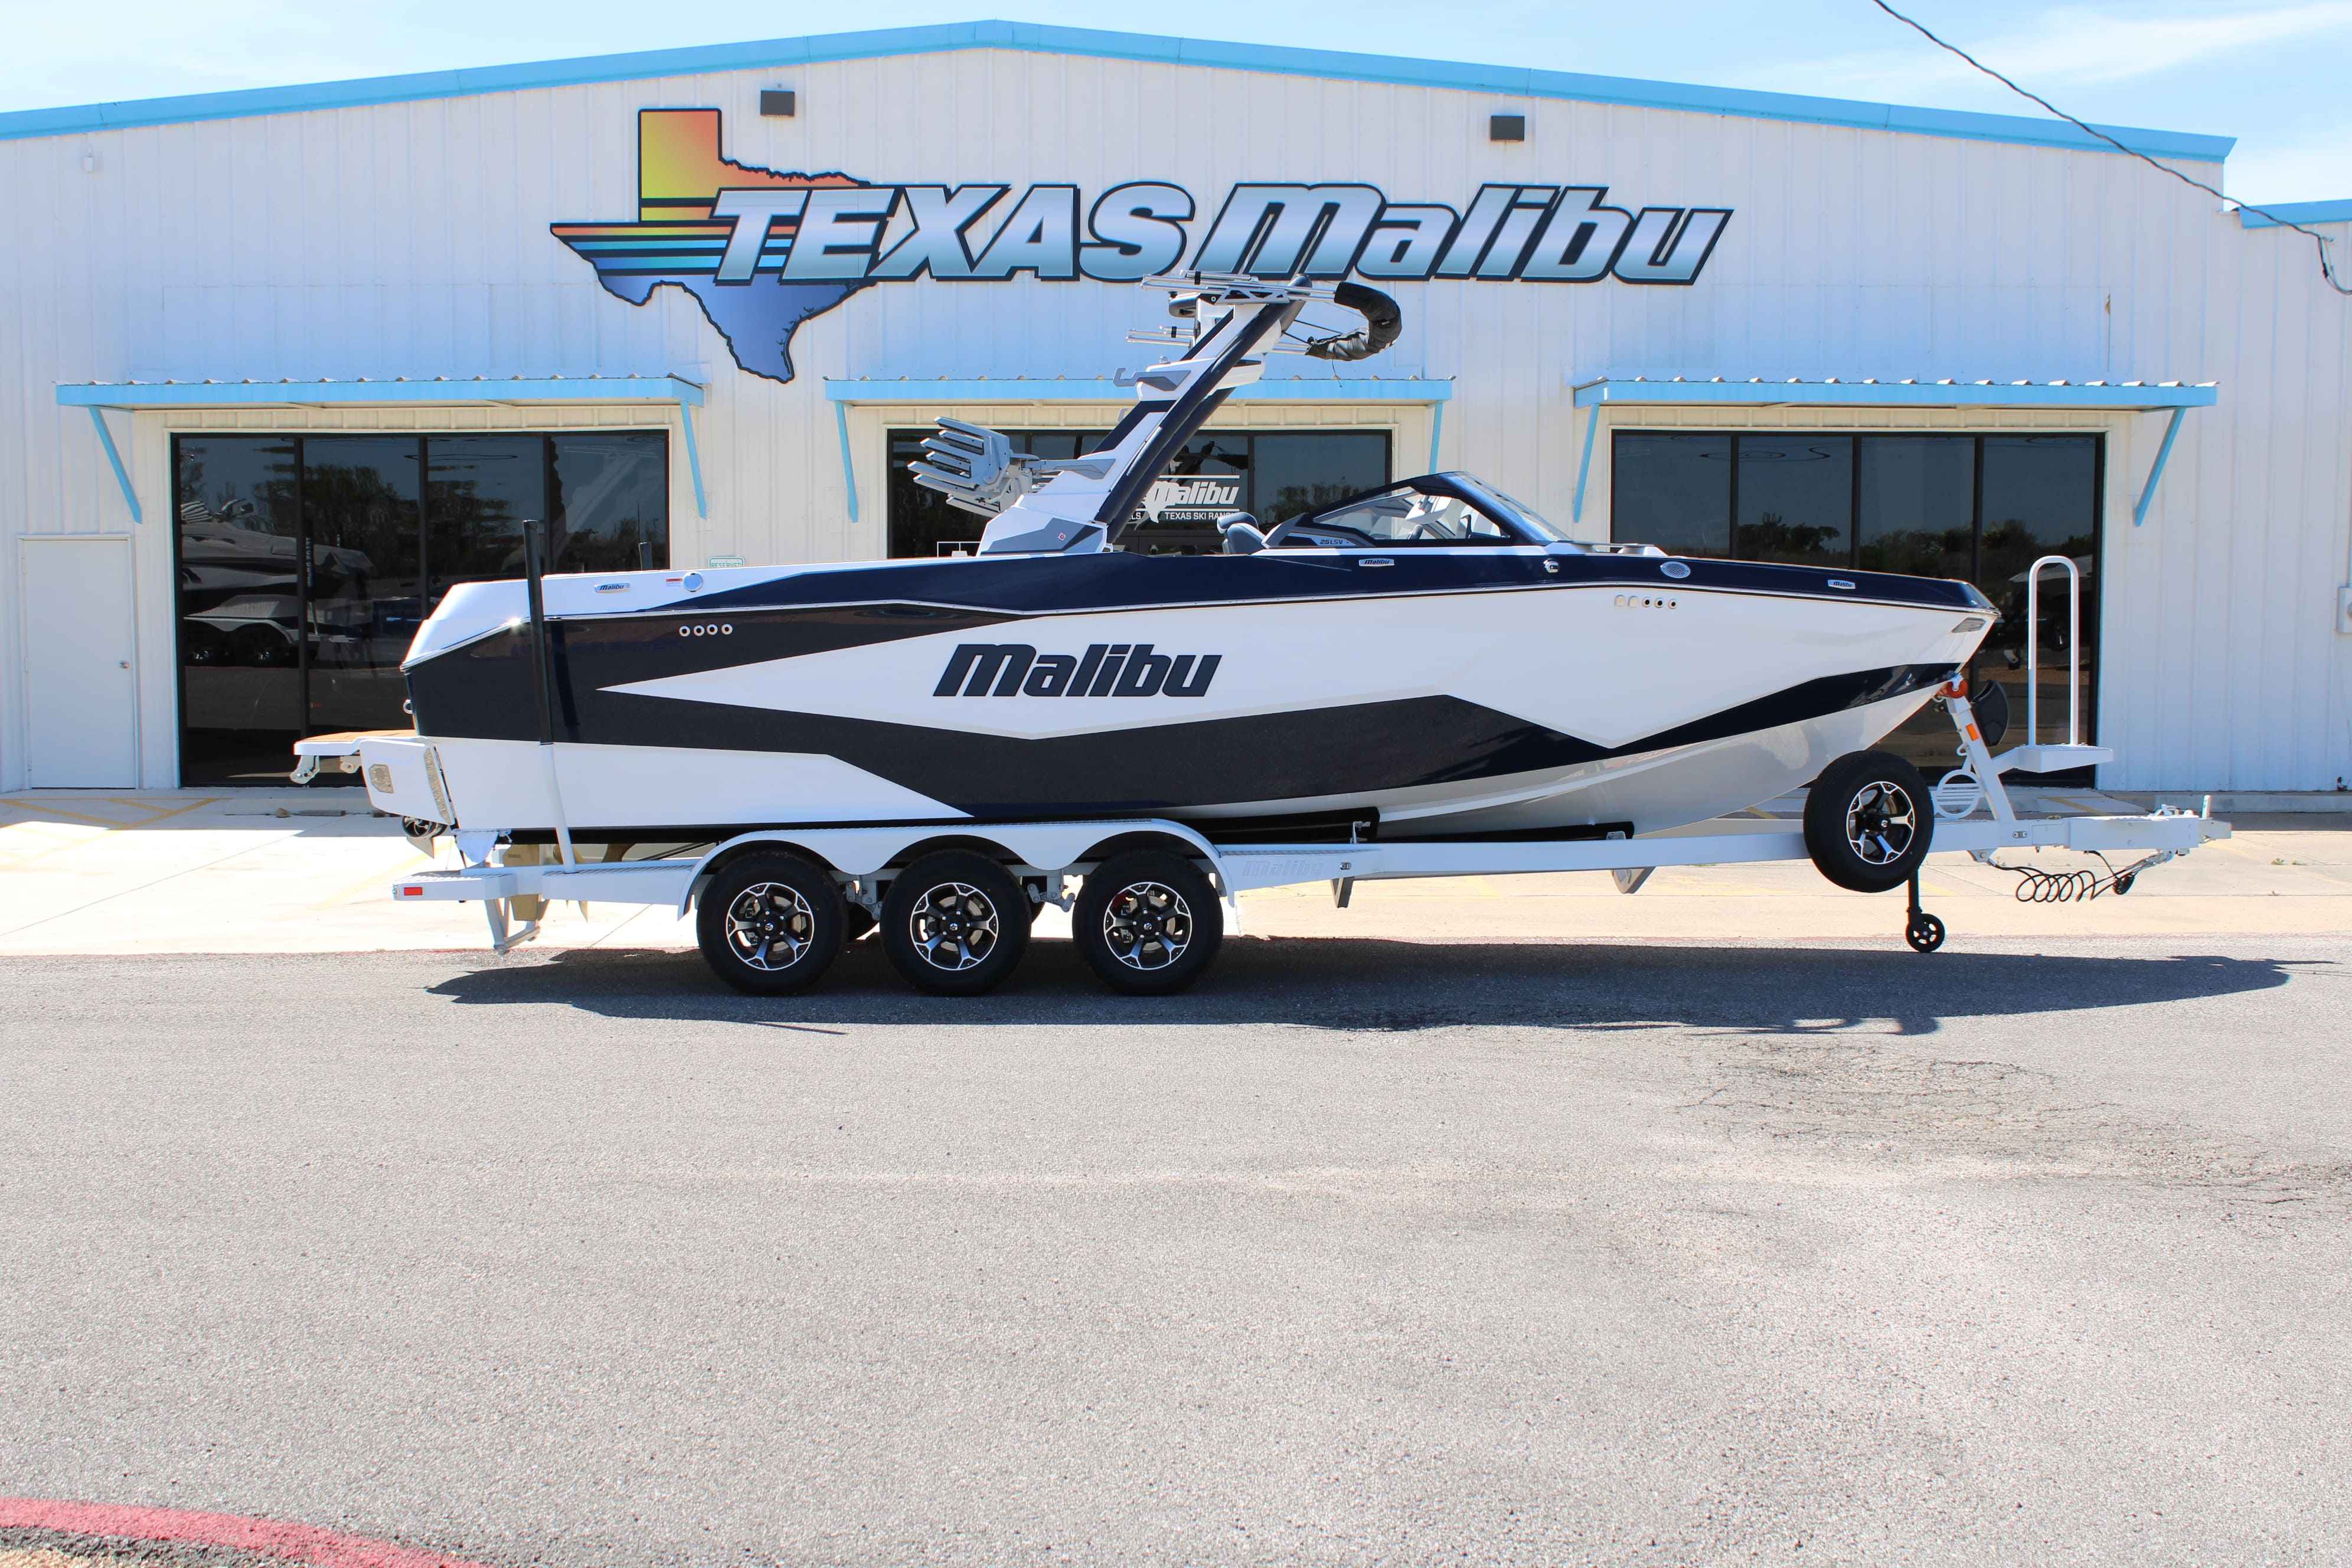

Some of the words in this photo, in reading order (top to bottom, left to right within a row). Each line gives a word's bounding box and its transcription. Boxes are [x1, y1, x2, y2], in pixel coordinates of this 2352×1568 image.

[714, 181, 1195, 285] TEXAS
[1190, 182, 1733, 286] Malibu
[1144, 481, 1239, 505] Malibu
[1165, 512, 1192, 520] TEXAS
[1193, 512, 1207, 520] SKI
[1208, 512, 1233, 520] RAN
[933, 643, 1222, 697] Malibu
[1242, 860, 1325, 877] Malibu
